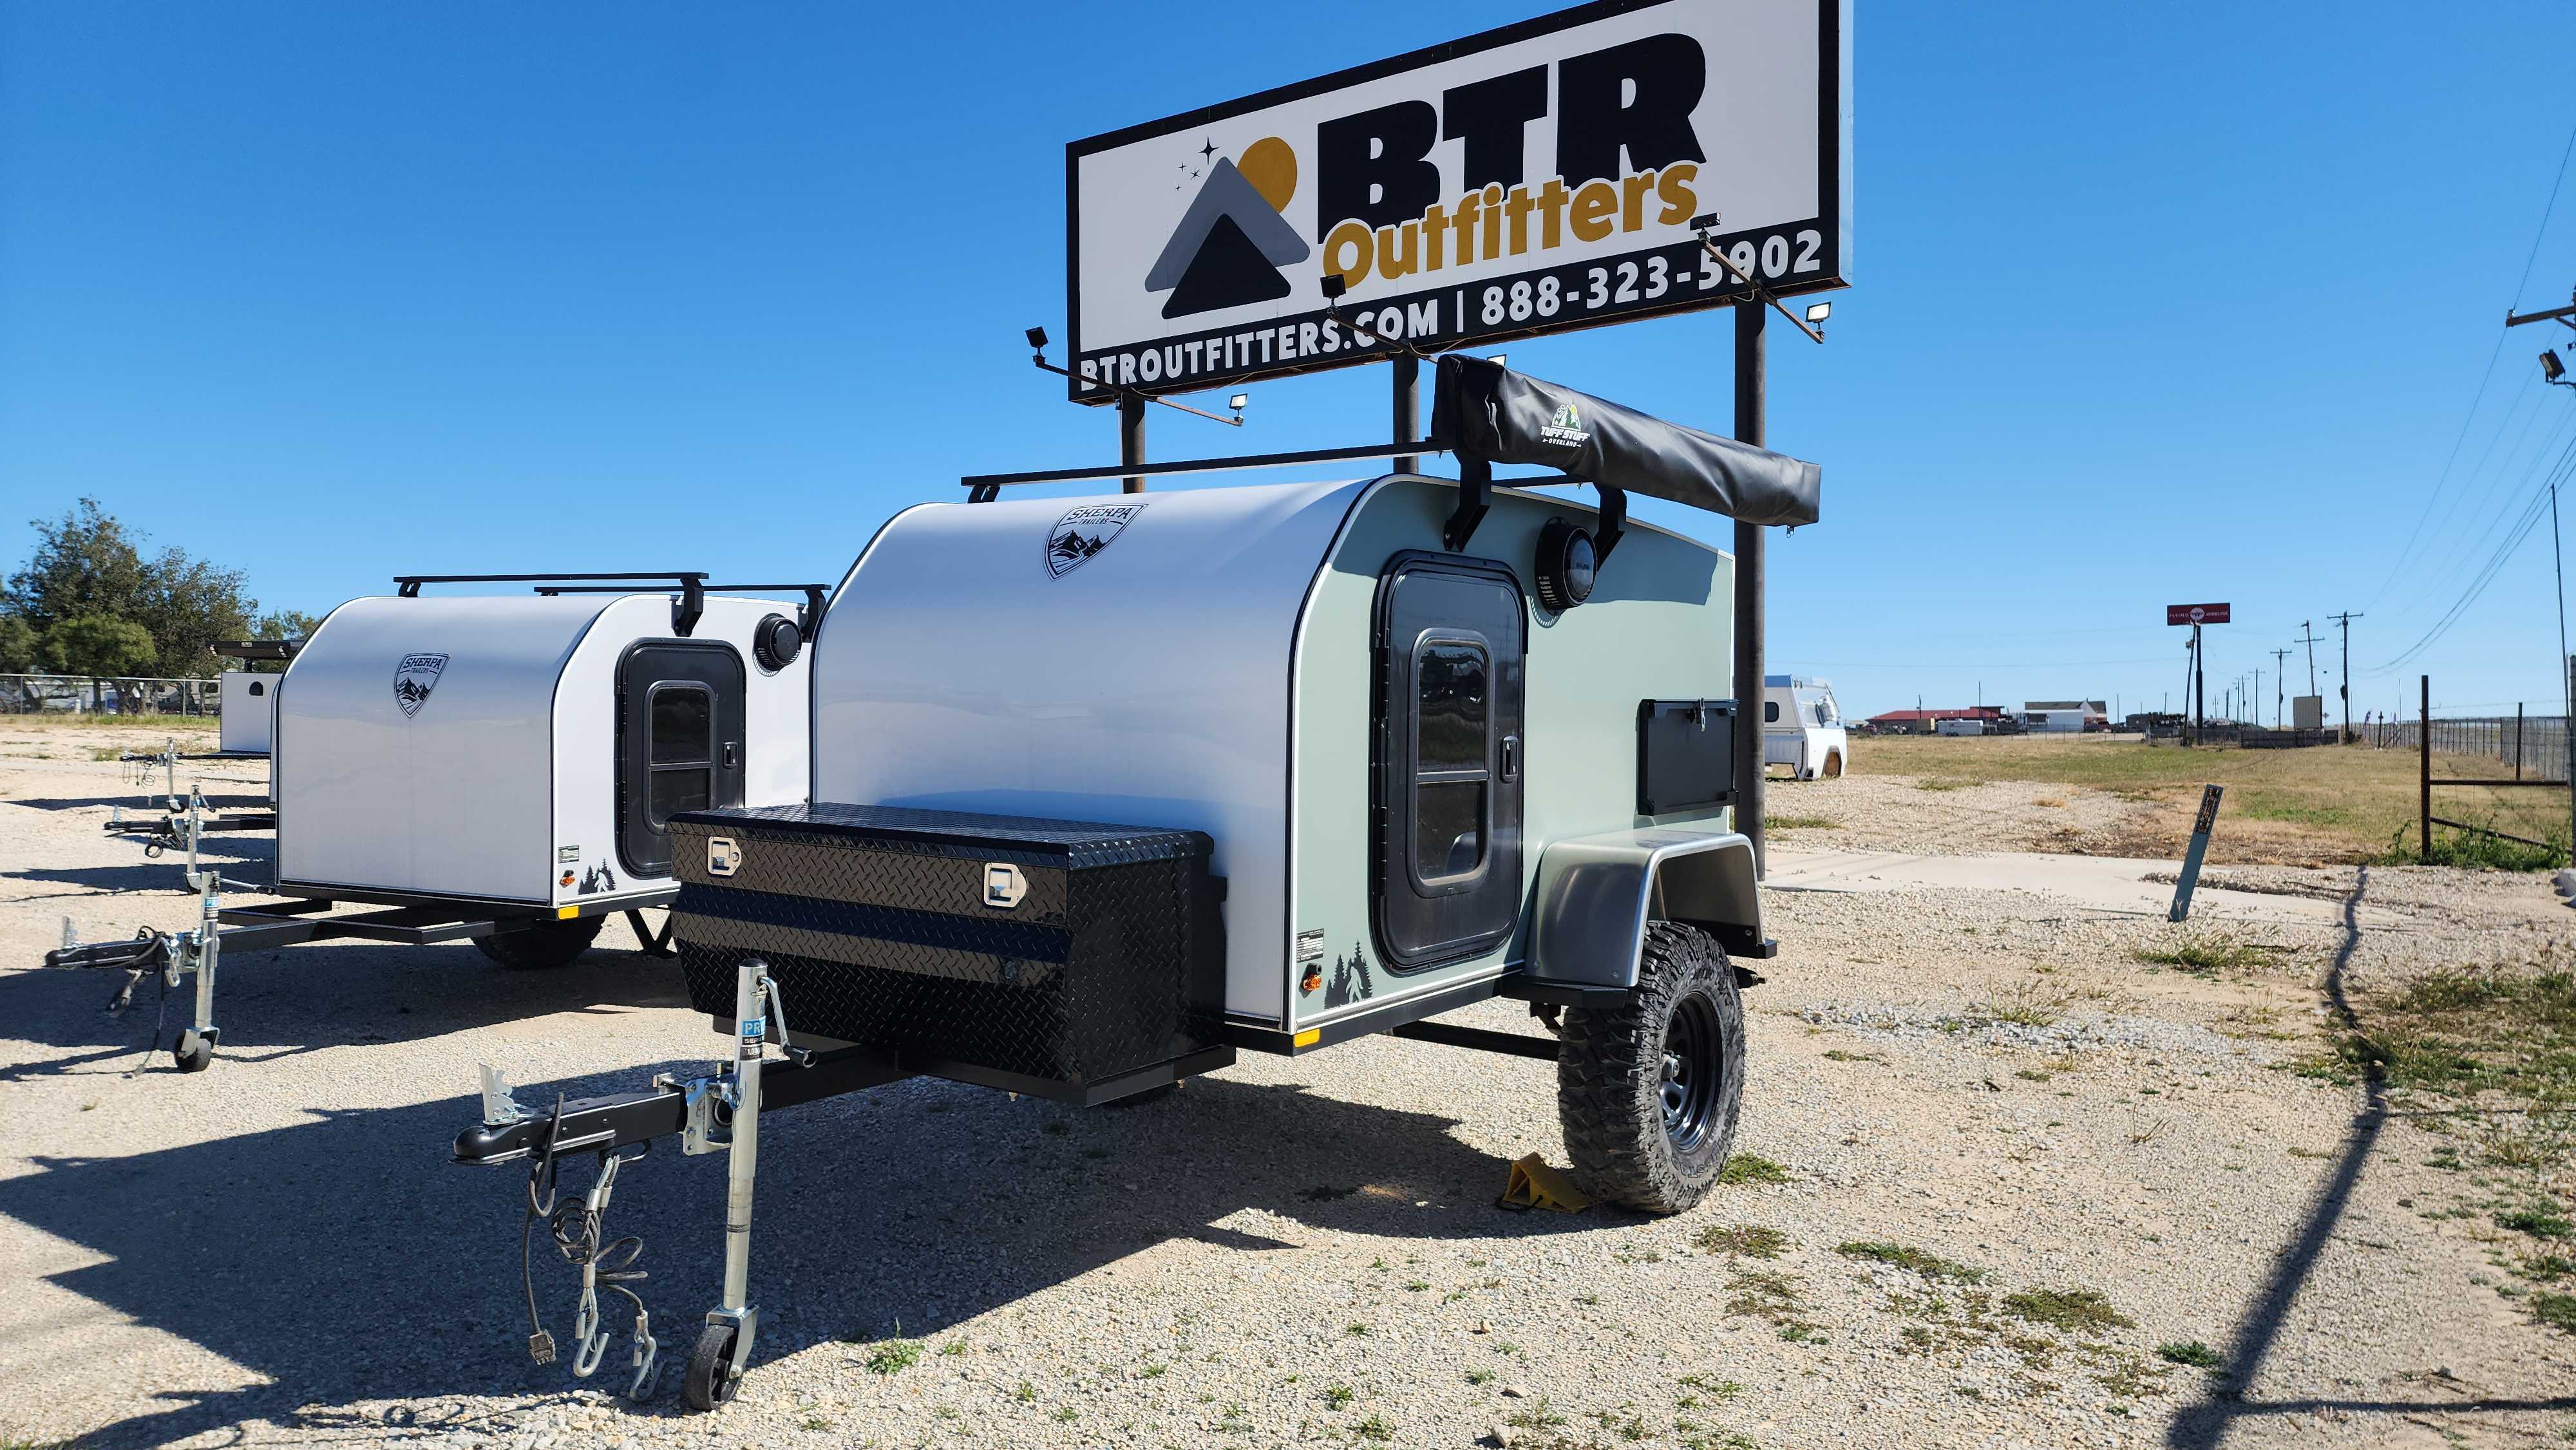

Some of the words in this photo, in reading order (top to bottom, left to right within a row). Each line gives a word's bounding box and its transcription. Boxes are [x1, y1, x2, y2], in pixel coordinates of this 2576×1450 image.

[1318, 33, 1707, 245] BTR
[1323, 164, 1699, 289] Outfitters
[1081, 299, 1438, 391] BTROUTFITTERS.COM
[1481, 229, 1822, 325] 888-323-5902
[1541, 426, 1564, 437] TUFF
[1562, 430, 1590, 441] STUFF
[1549, 438, 1577, 447] OVERLAND
[1067, 508, 1133, 520] SHERPA
[403, 658, 442, 669] SHERPA
